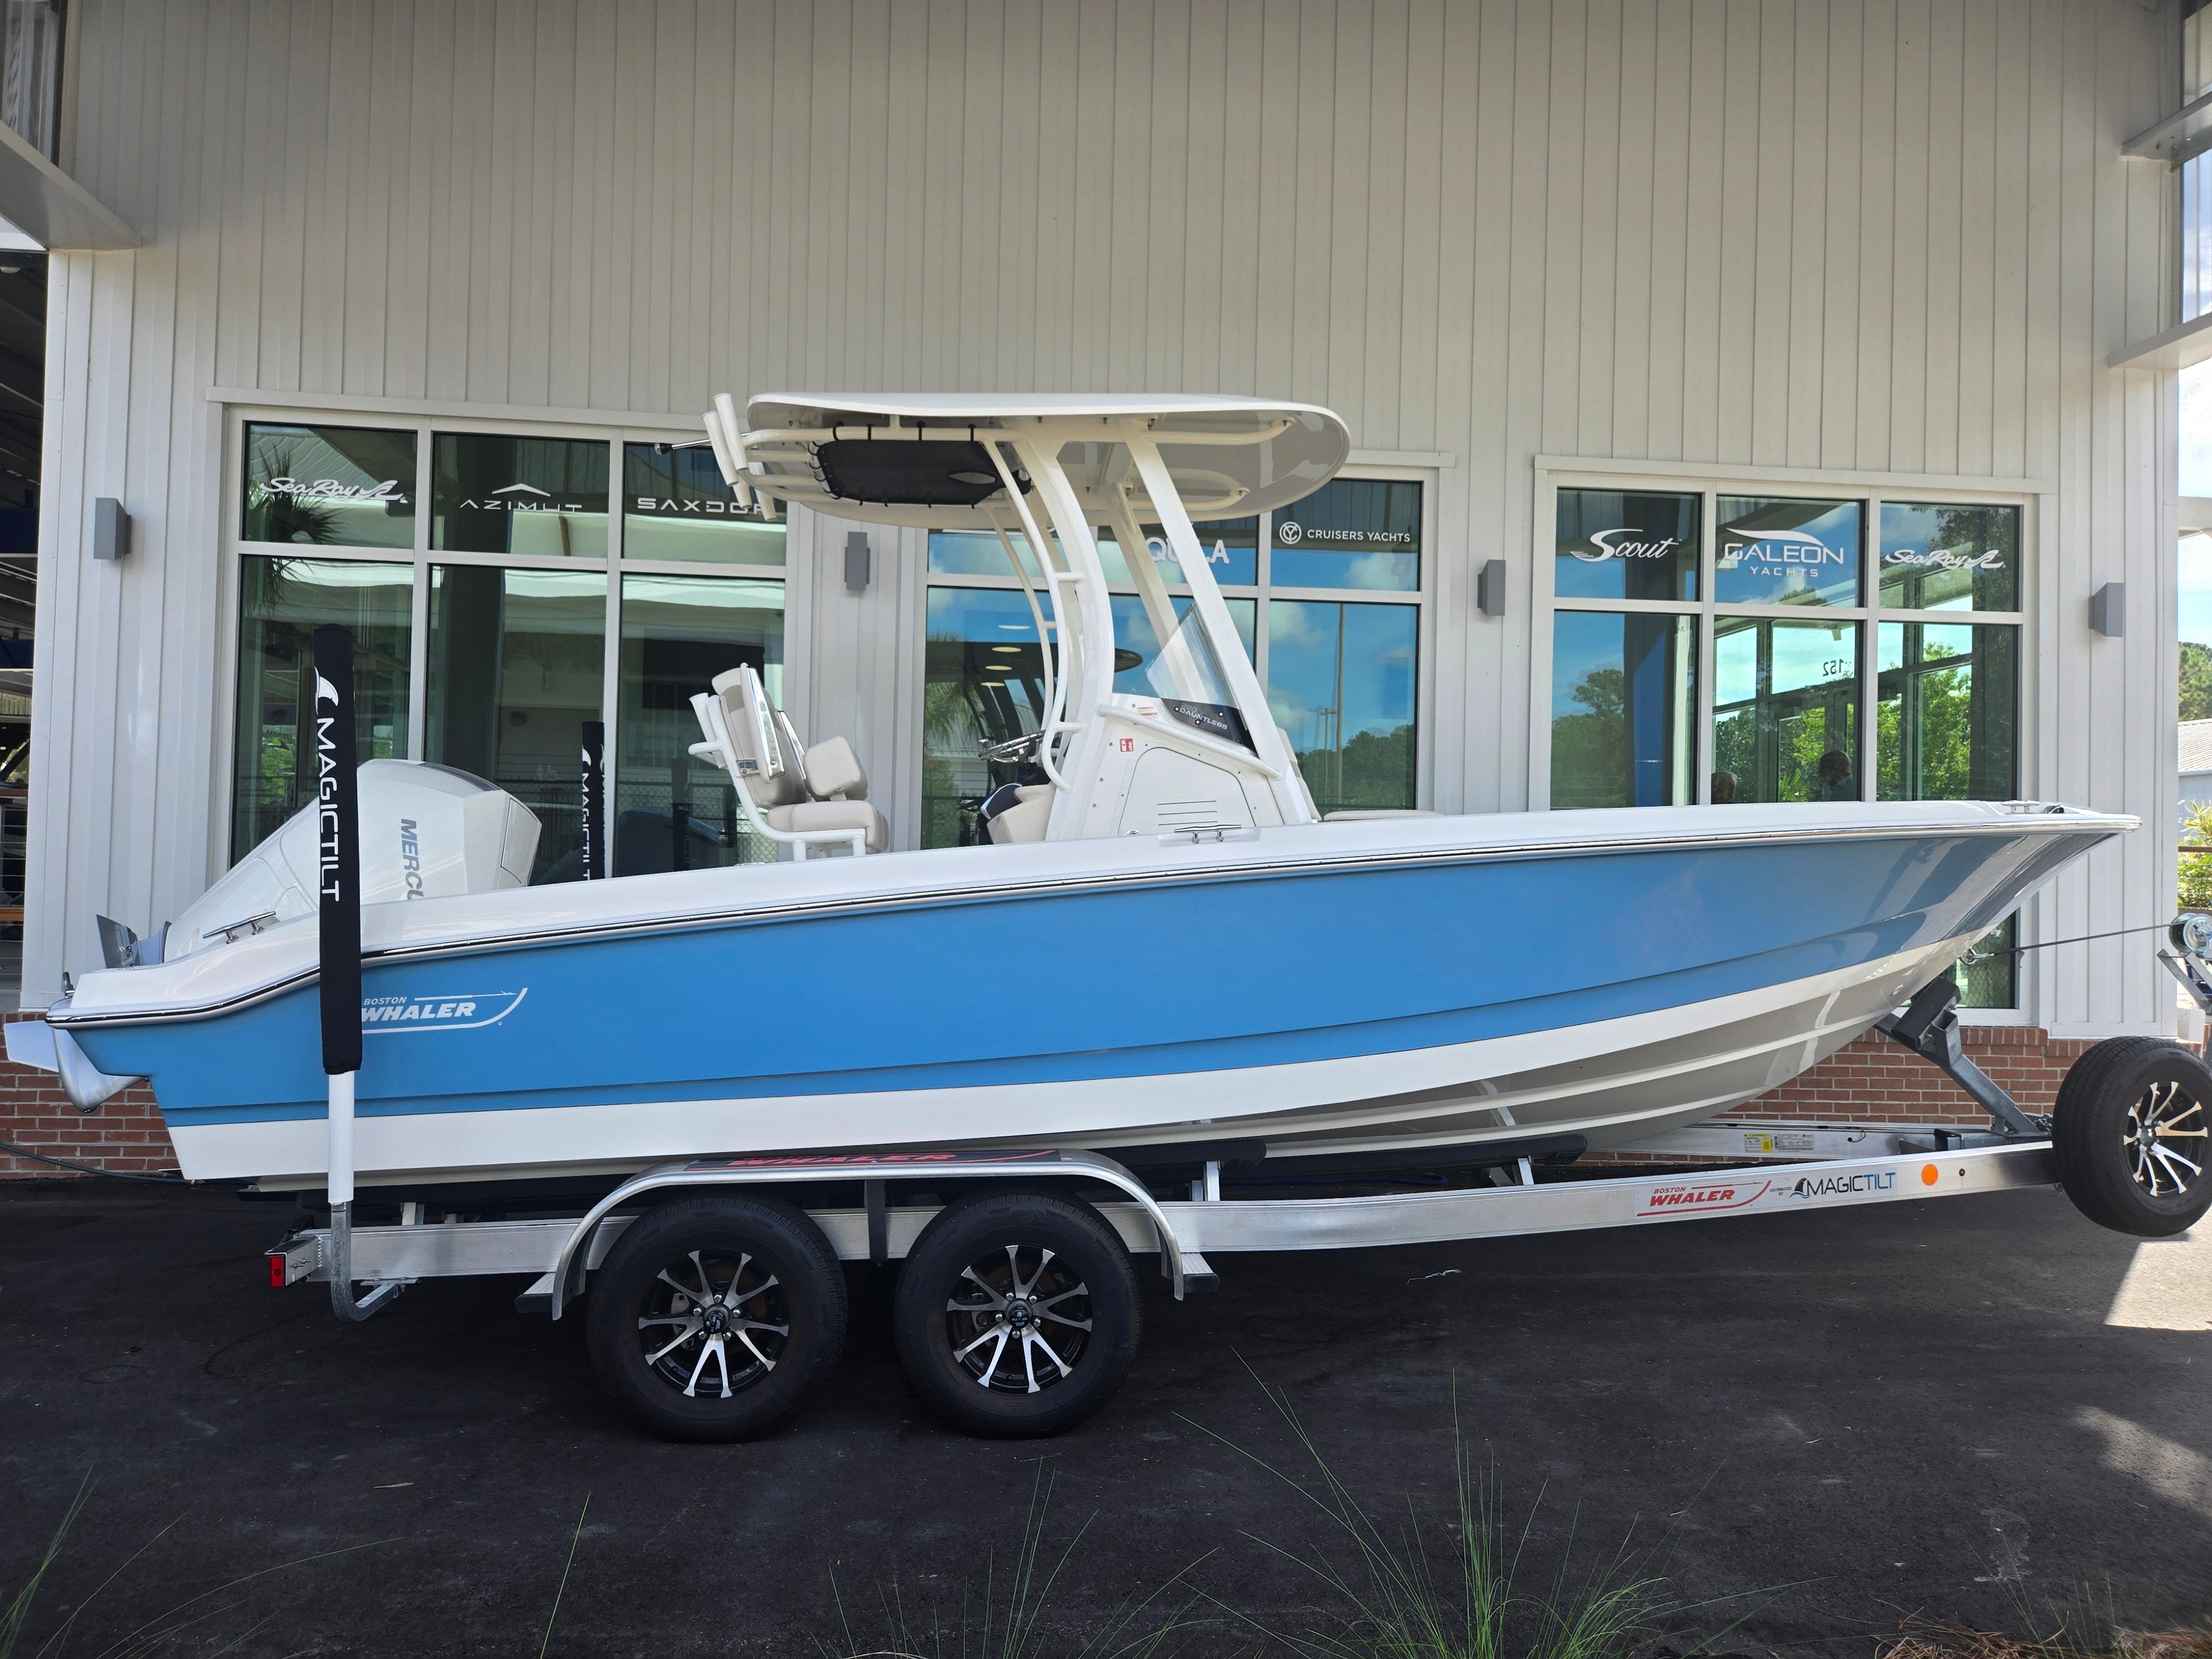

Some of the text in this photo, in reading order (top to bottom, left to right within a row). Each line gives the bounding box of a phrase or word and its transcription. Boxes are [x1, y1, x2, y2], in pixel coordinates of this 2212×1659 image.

[260, 477, 359, 501] Sea Ray
[460, 499, 582, 513] AZIMUT
[1307, 529, 1410, 542] CRUISERS YACHTS
[1570, 528, 1679, 562] Scout
[1724, 542, 1844, 565] GALEON
[1885, 549, 1968, 570] Sea Ray
[1750, 566, 1818, 577] YACHTS
[1181, 703, 1197, 713] 220
[1179, 708, 1228, 730] DAUNTLESS
[317, 717, 340, 902] MAGICTILT
[363, 997, 407, 1005] BOSTON
[361, 1002, 476, 1022] WHALER
[1807, 1172, 1896, 1196] MAGICTILT
[1650, 1190, 1735, 1207] WHALER
